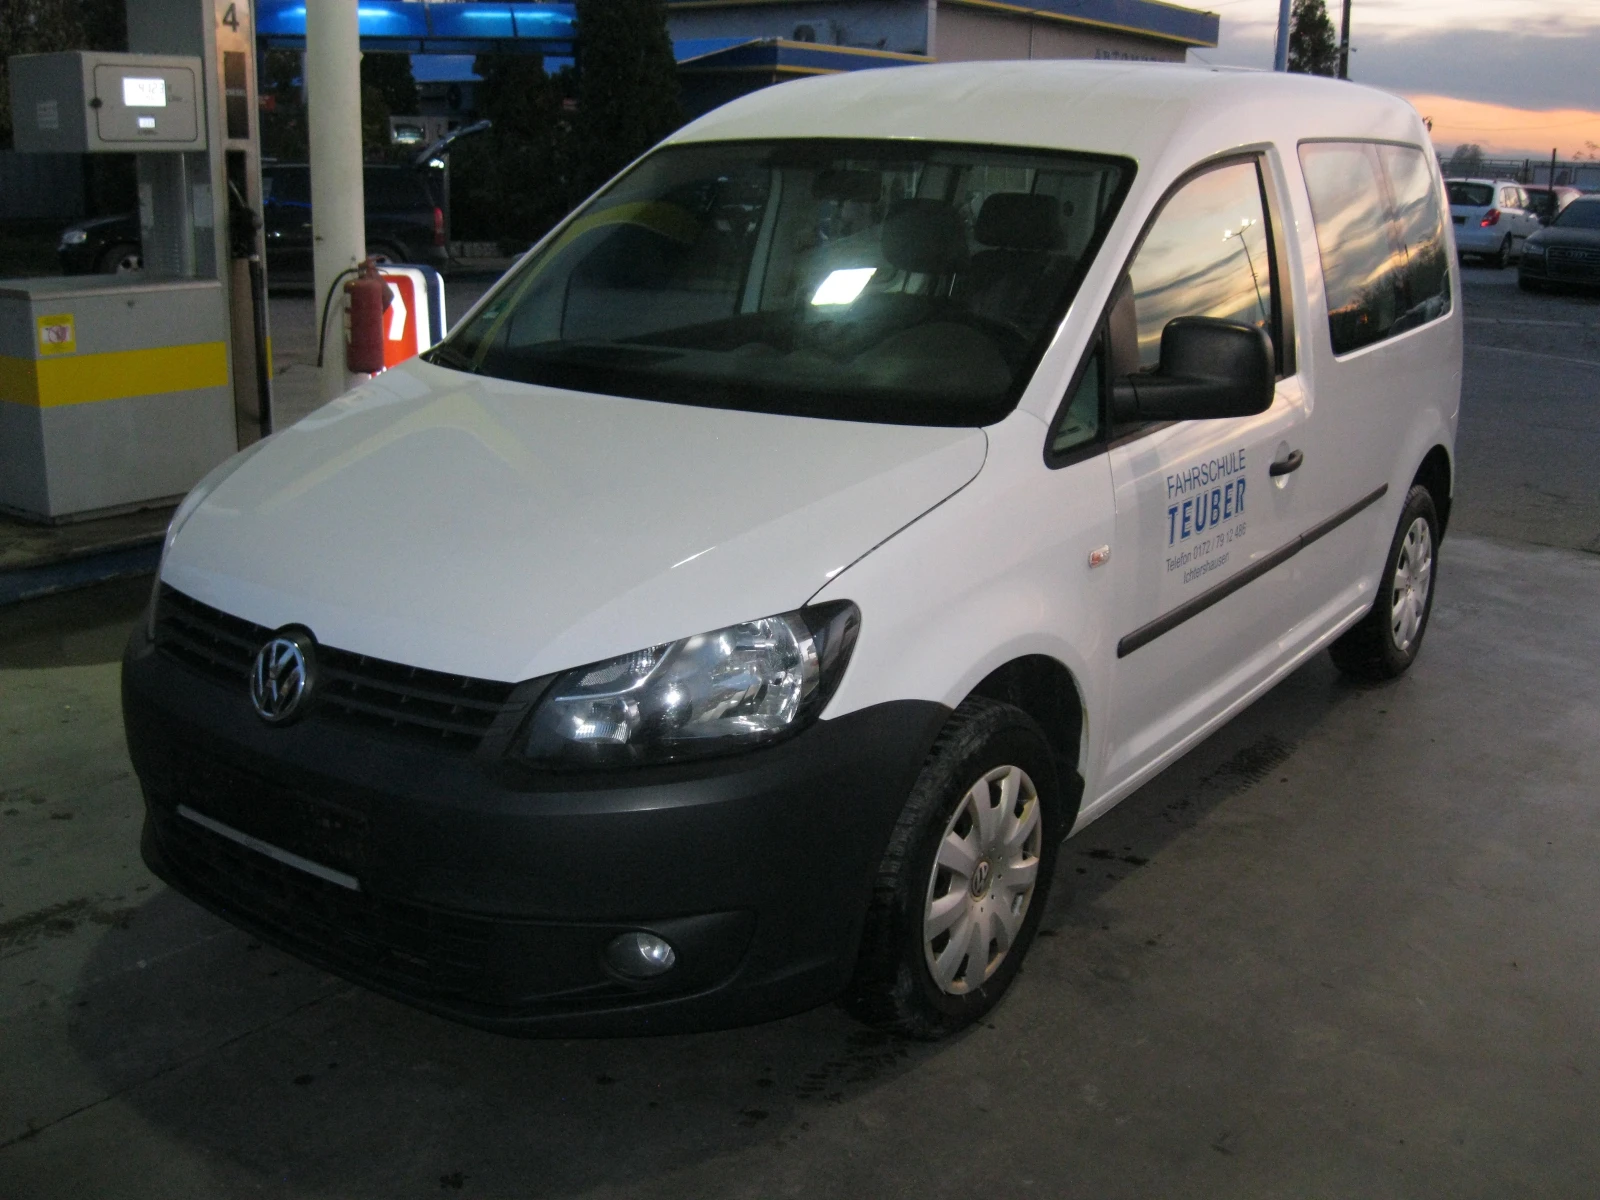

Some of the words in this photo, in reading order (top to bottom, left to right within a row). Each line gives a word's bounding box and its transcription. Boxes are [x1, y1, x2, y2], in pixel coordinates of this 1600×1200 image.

[222, 3, 240, 33] 4
[1166, 448, 1246, 499] FAHRSCHULE
[1167, 475, 1247, 548] TEUBER
[1166, 551, 1192, 573] Telefon
[1193, 539, 1211, 560] 0172
[1216, 532, 1225, 549] 79
[1226, 528, 1234, 544] 12
[1183, 551, 1230, 585] Ichtershausen
[250, 638, 306, 721] VW
